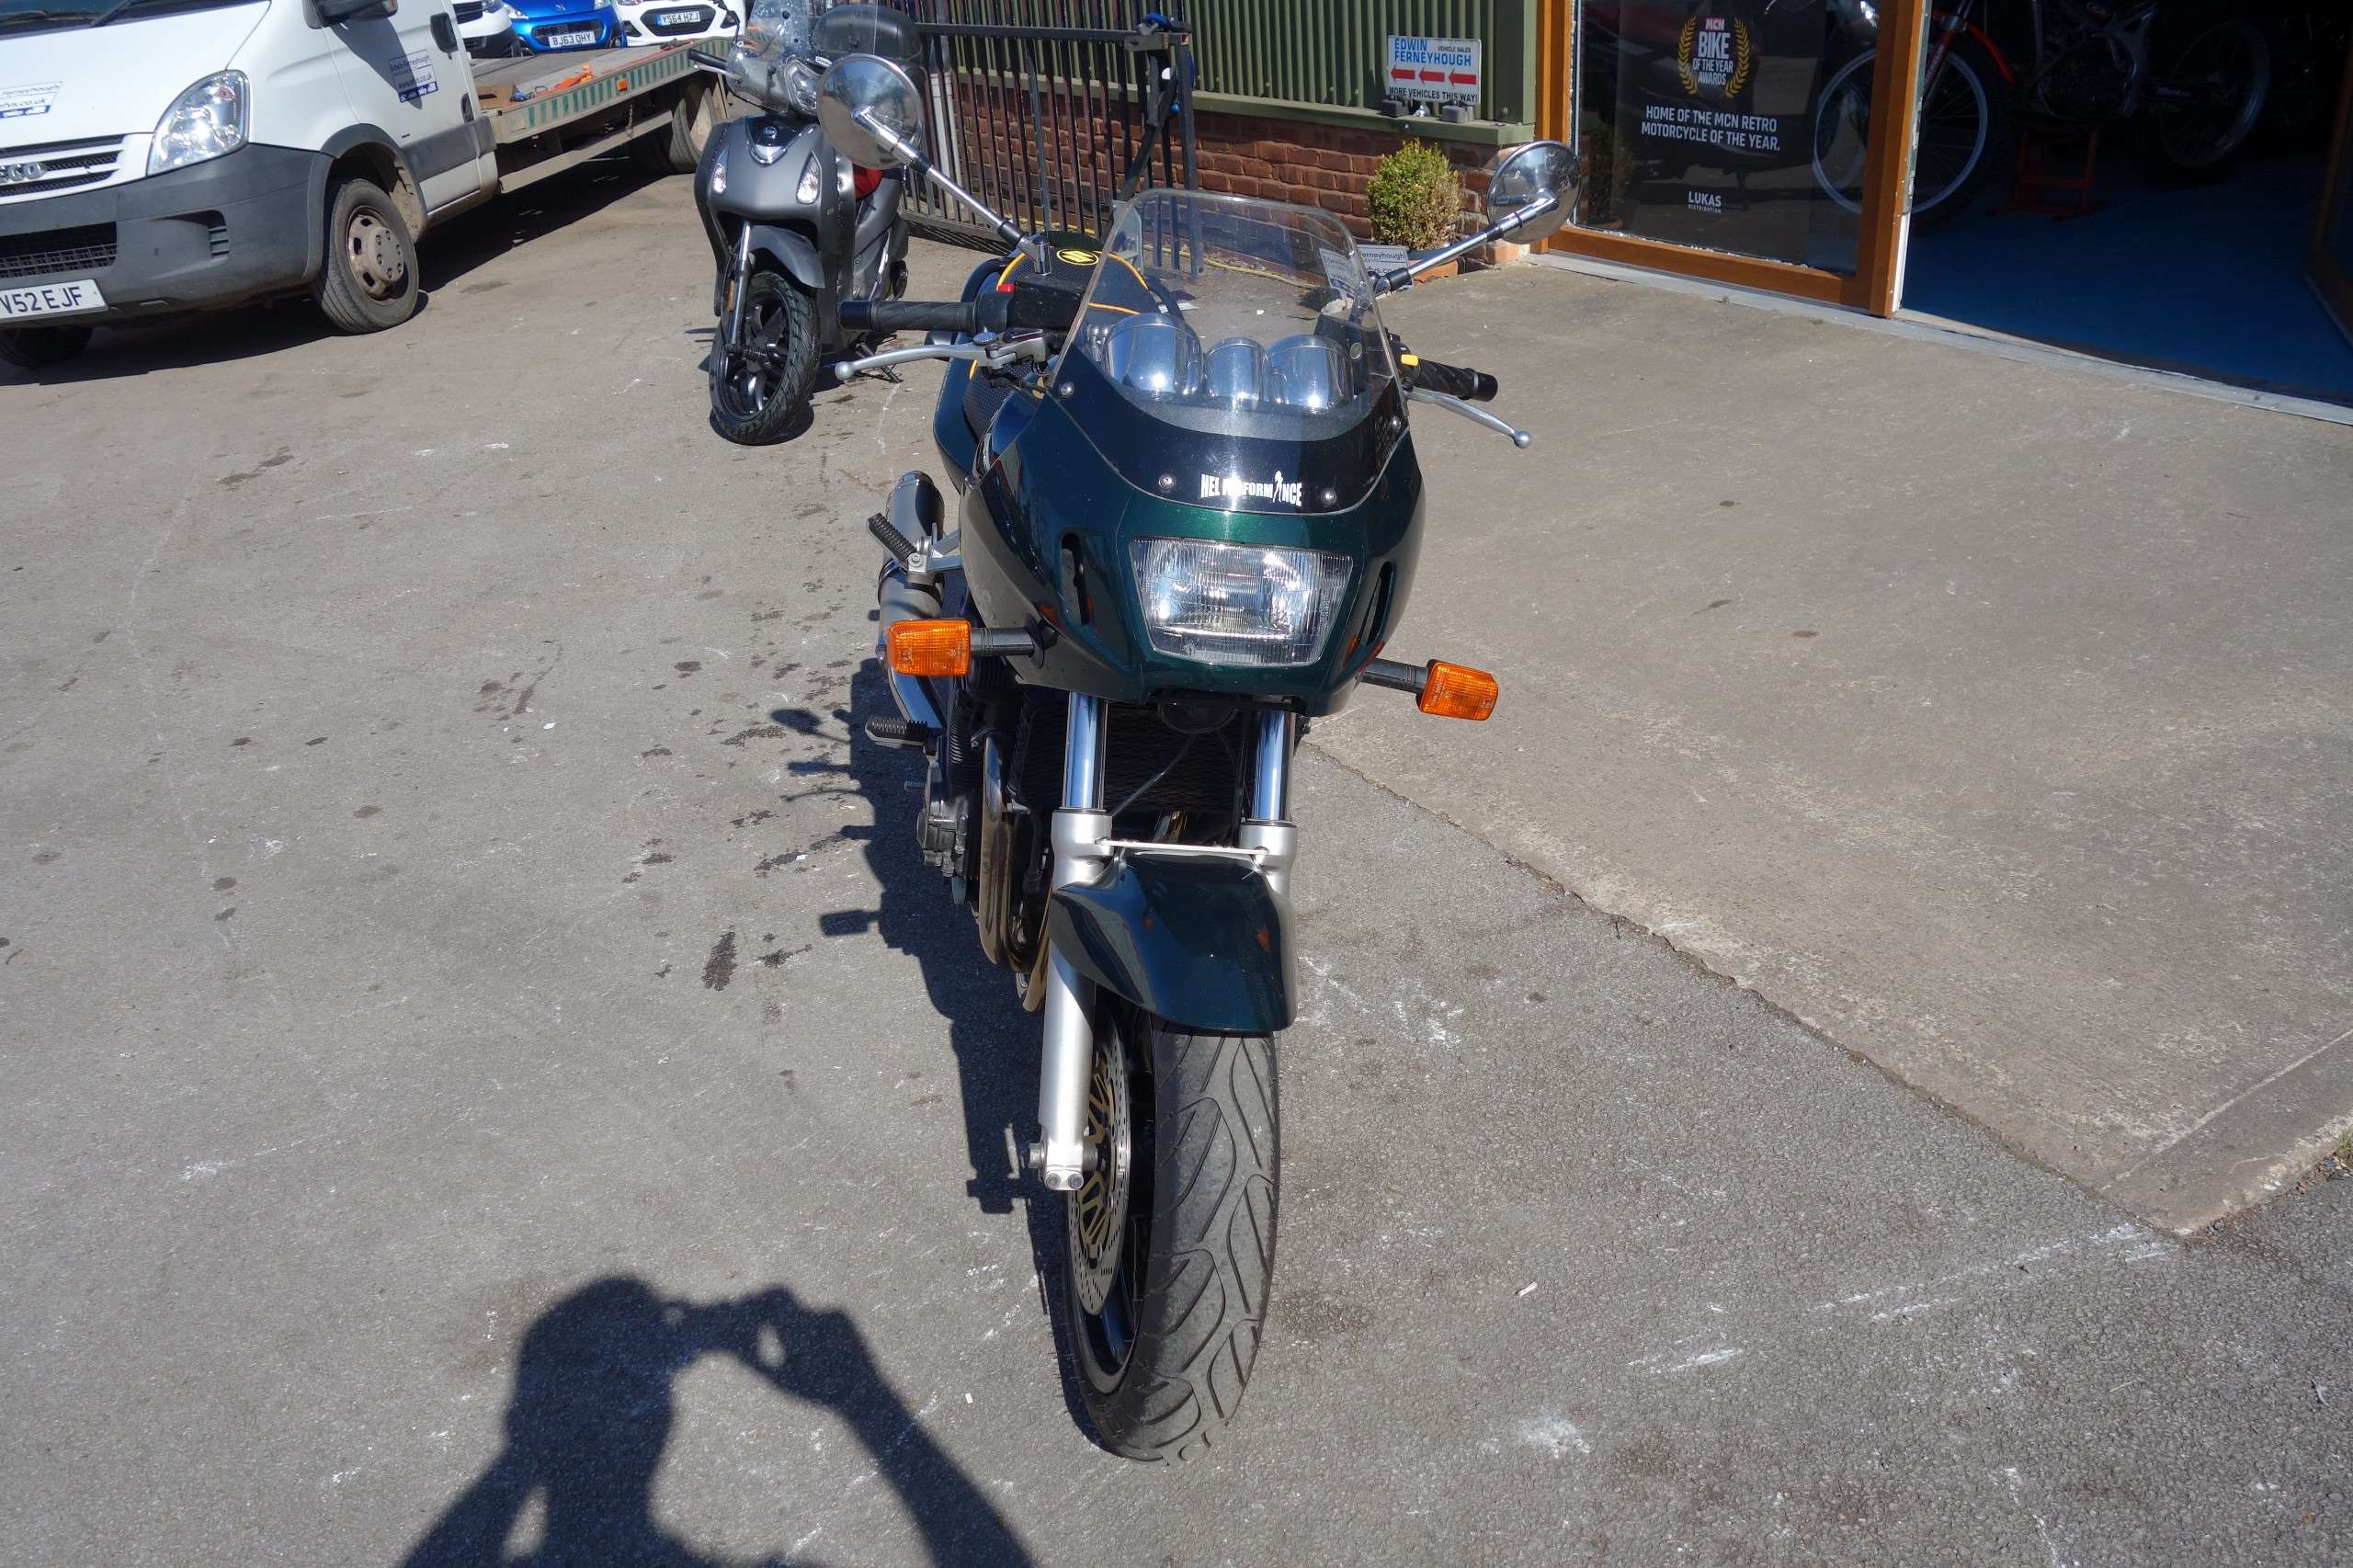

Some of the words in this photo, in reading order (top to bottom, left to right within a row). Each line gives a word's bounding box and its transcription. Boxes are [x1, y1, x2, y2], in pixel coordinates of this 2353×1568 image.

[1705, 18, 1725, 30] MCN
[552, 35, 574, 46] BJ63
[1394, 39, 1427, 51] EDWIN
[1698, 30, 1731, 60] BIKE
[1394, 51, 1472, 66] FERNEYHOUGH
[1692, 58, 1700, 70] OF
[1701, 59, 1714, 72] THE
[1715, 59, 1734, 73] YEAR
[1698, 72, 1727, 85] AWARDS
[1390, 86, 1407, 97] MORE
[1408, 88, 1440, 99] VEHICLES
[1442, 91, 1458, 101] THIS
[1460, 93, 1478, 103] WAY!
[1646, 106, 1675, 120] HOME
[1677, 108, 1691, 122] OF
[1692, 109, 1711, 126] THE
[1714, 112, 1739, 128] MCN
[1741, 115, 1778, 132] RETRO
[1642, 121, 1708, 142] MOTORCYCLE
[1710, 130, 1724, 143] OF
[1726, 131, 1745, 146] THE
[1748, 134, 1780, 151] YEAR.
[1688, 191, 1721, 207] LUKAS
[1361, 251, 1404, 260] erneyhough
[41, 287, 82, 309] EJF
[1200, 474, 1221, 498] HEL
